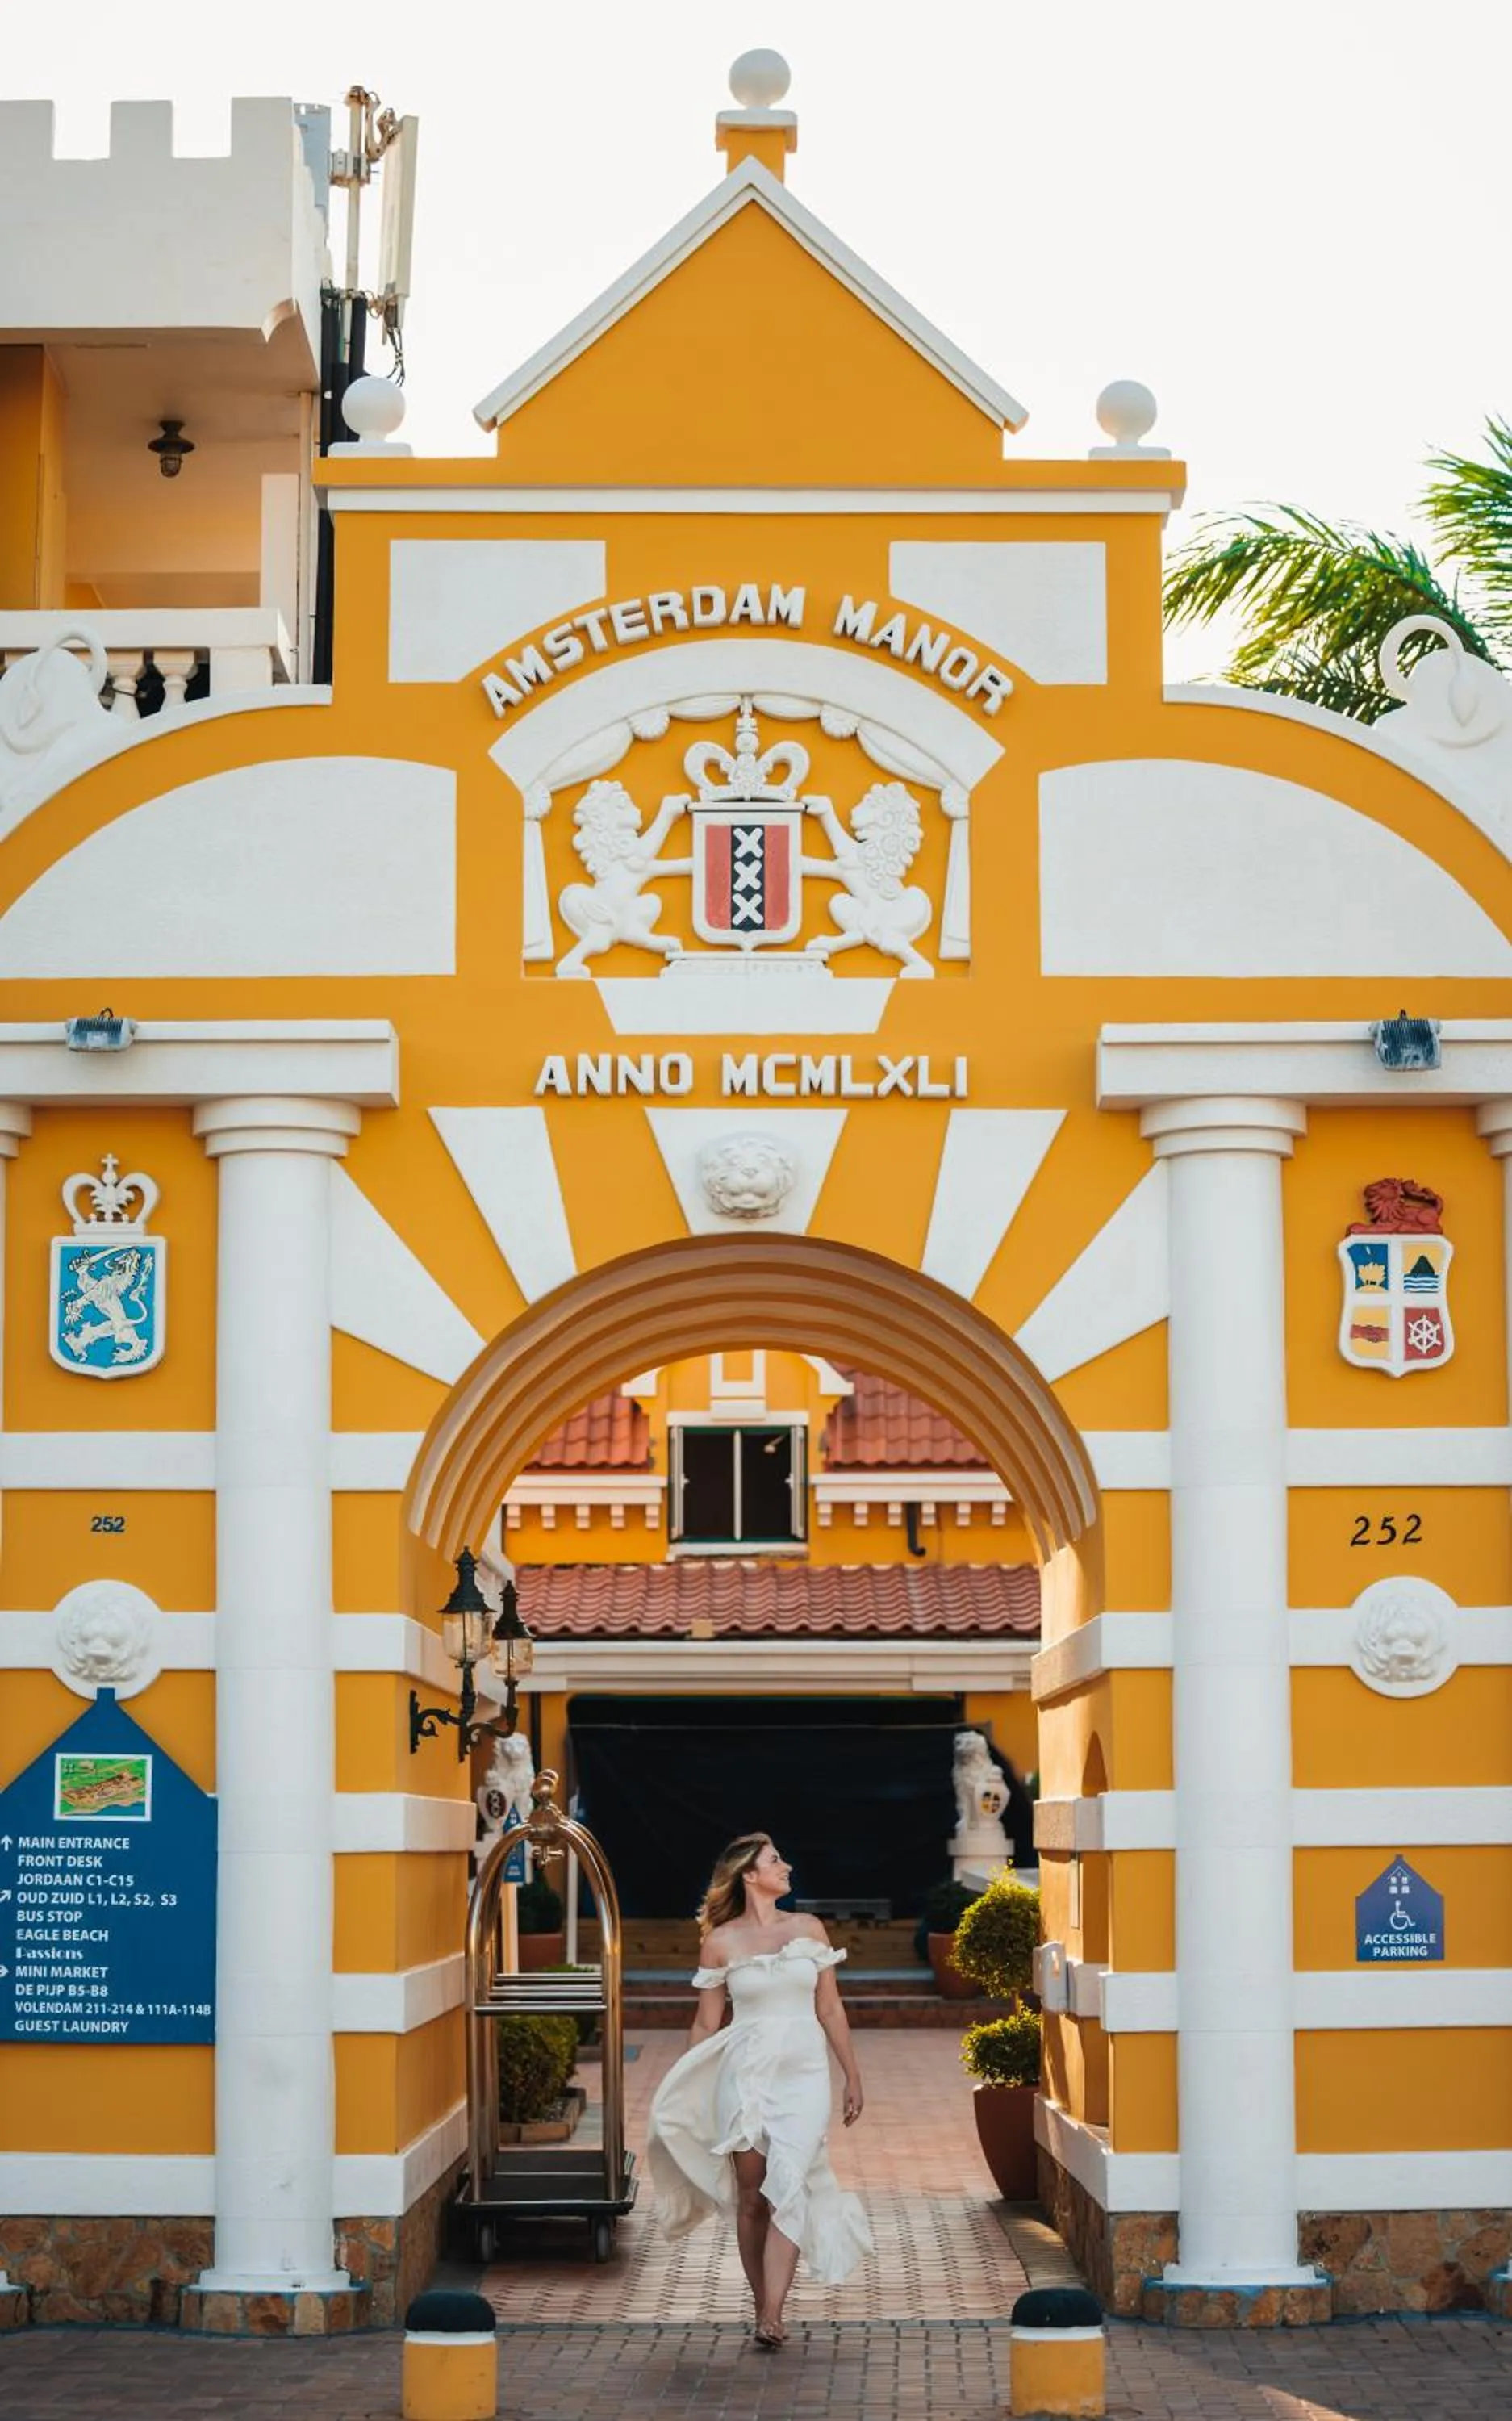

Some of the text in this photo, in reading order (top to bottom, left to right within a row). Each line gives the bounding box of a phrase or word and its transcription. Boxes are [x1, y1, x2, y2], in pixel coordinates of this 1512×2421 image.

[482, 583, 1013, 718] AMSTERDAM MANOR
[534, 1052, 968, 1098] ANNO MCMLXLI
[90, 1516, 126, 1533] 252
[1350, 1513, 1423, 1547] 252
[19, 1837, 130, 1849] MAIN ENTRANCE
[18, 1855, 102, 1867] FRONT DESK
[17, 1873, 134, 1887] JORDAAN C1-C15
[17, 1892, 48, 1904] OUD
[51, 1892, 85, 1905] ZUID
[88, 1892, 107, 1905] L1,
[111, 1893, 131, 1906] L2,
[161, 1894, 177, 1905] S3
[17, 1910, 83, 1922] BUS STOP
[16, 1929, 108, 1942] EAGLE BEACH
[1364, 1933, 1436, 1945] ACCESSIBLE
[1372, 1946, 1429, 1957] PARKING
[15, 1965, 108, 1978] MINI MARKET
[15, 1984, 108, 1997] DE PIJP B5-B8
[15, 2001, 83, 2013] VOLENDAM
[86, 2002, 133, 2014] 211-214
[136, 2003, 144, 2015] &
[15, 2020, 129, 2033] GUEST LAUNDRY
